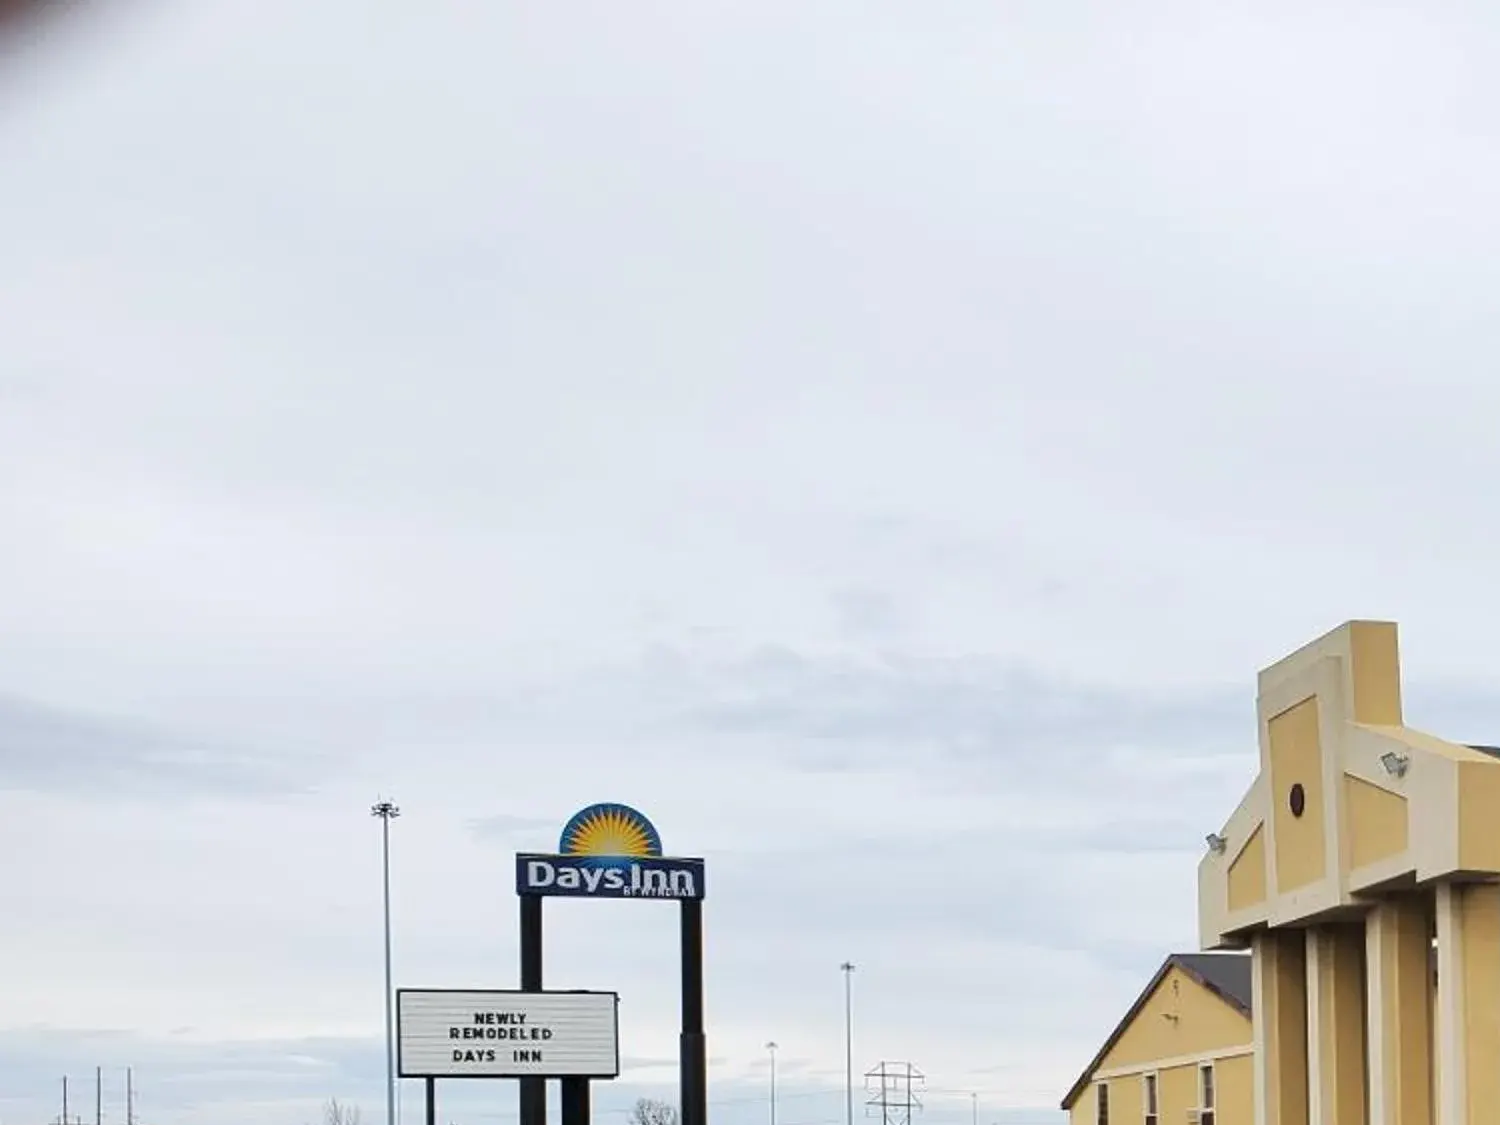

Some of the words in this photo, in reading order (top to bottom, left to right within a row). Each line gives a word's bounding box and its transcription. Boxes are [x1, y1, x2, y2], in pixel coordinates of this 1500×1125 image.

[527, 861, 625, 893] Days
[630, 863, 695, 890] Inn
[474, 1013, 527, 1024] NEWLY
[449, 1027, 553, 1040] REMODELED
[453, 1049, 496, 1062] DAYS
[513, 1050, 542, 1062] INN
